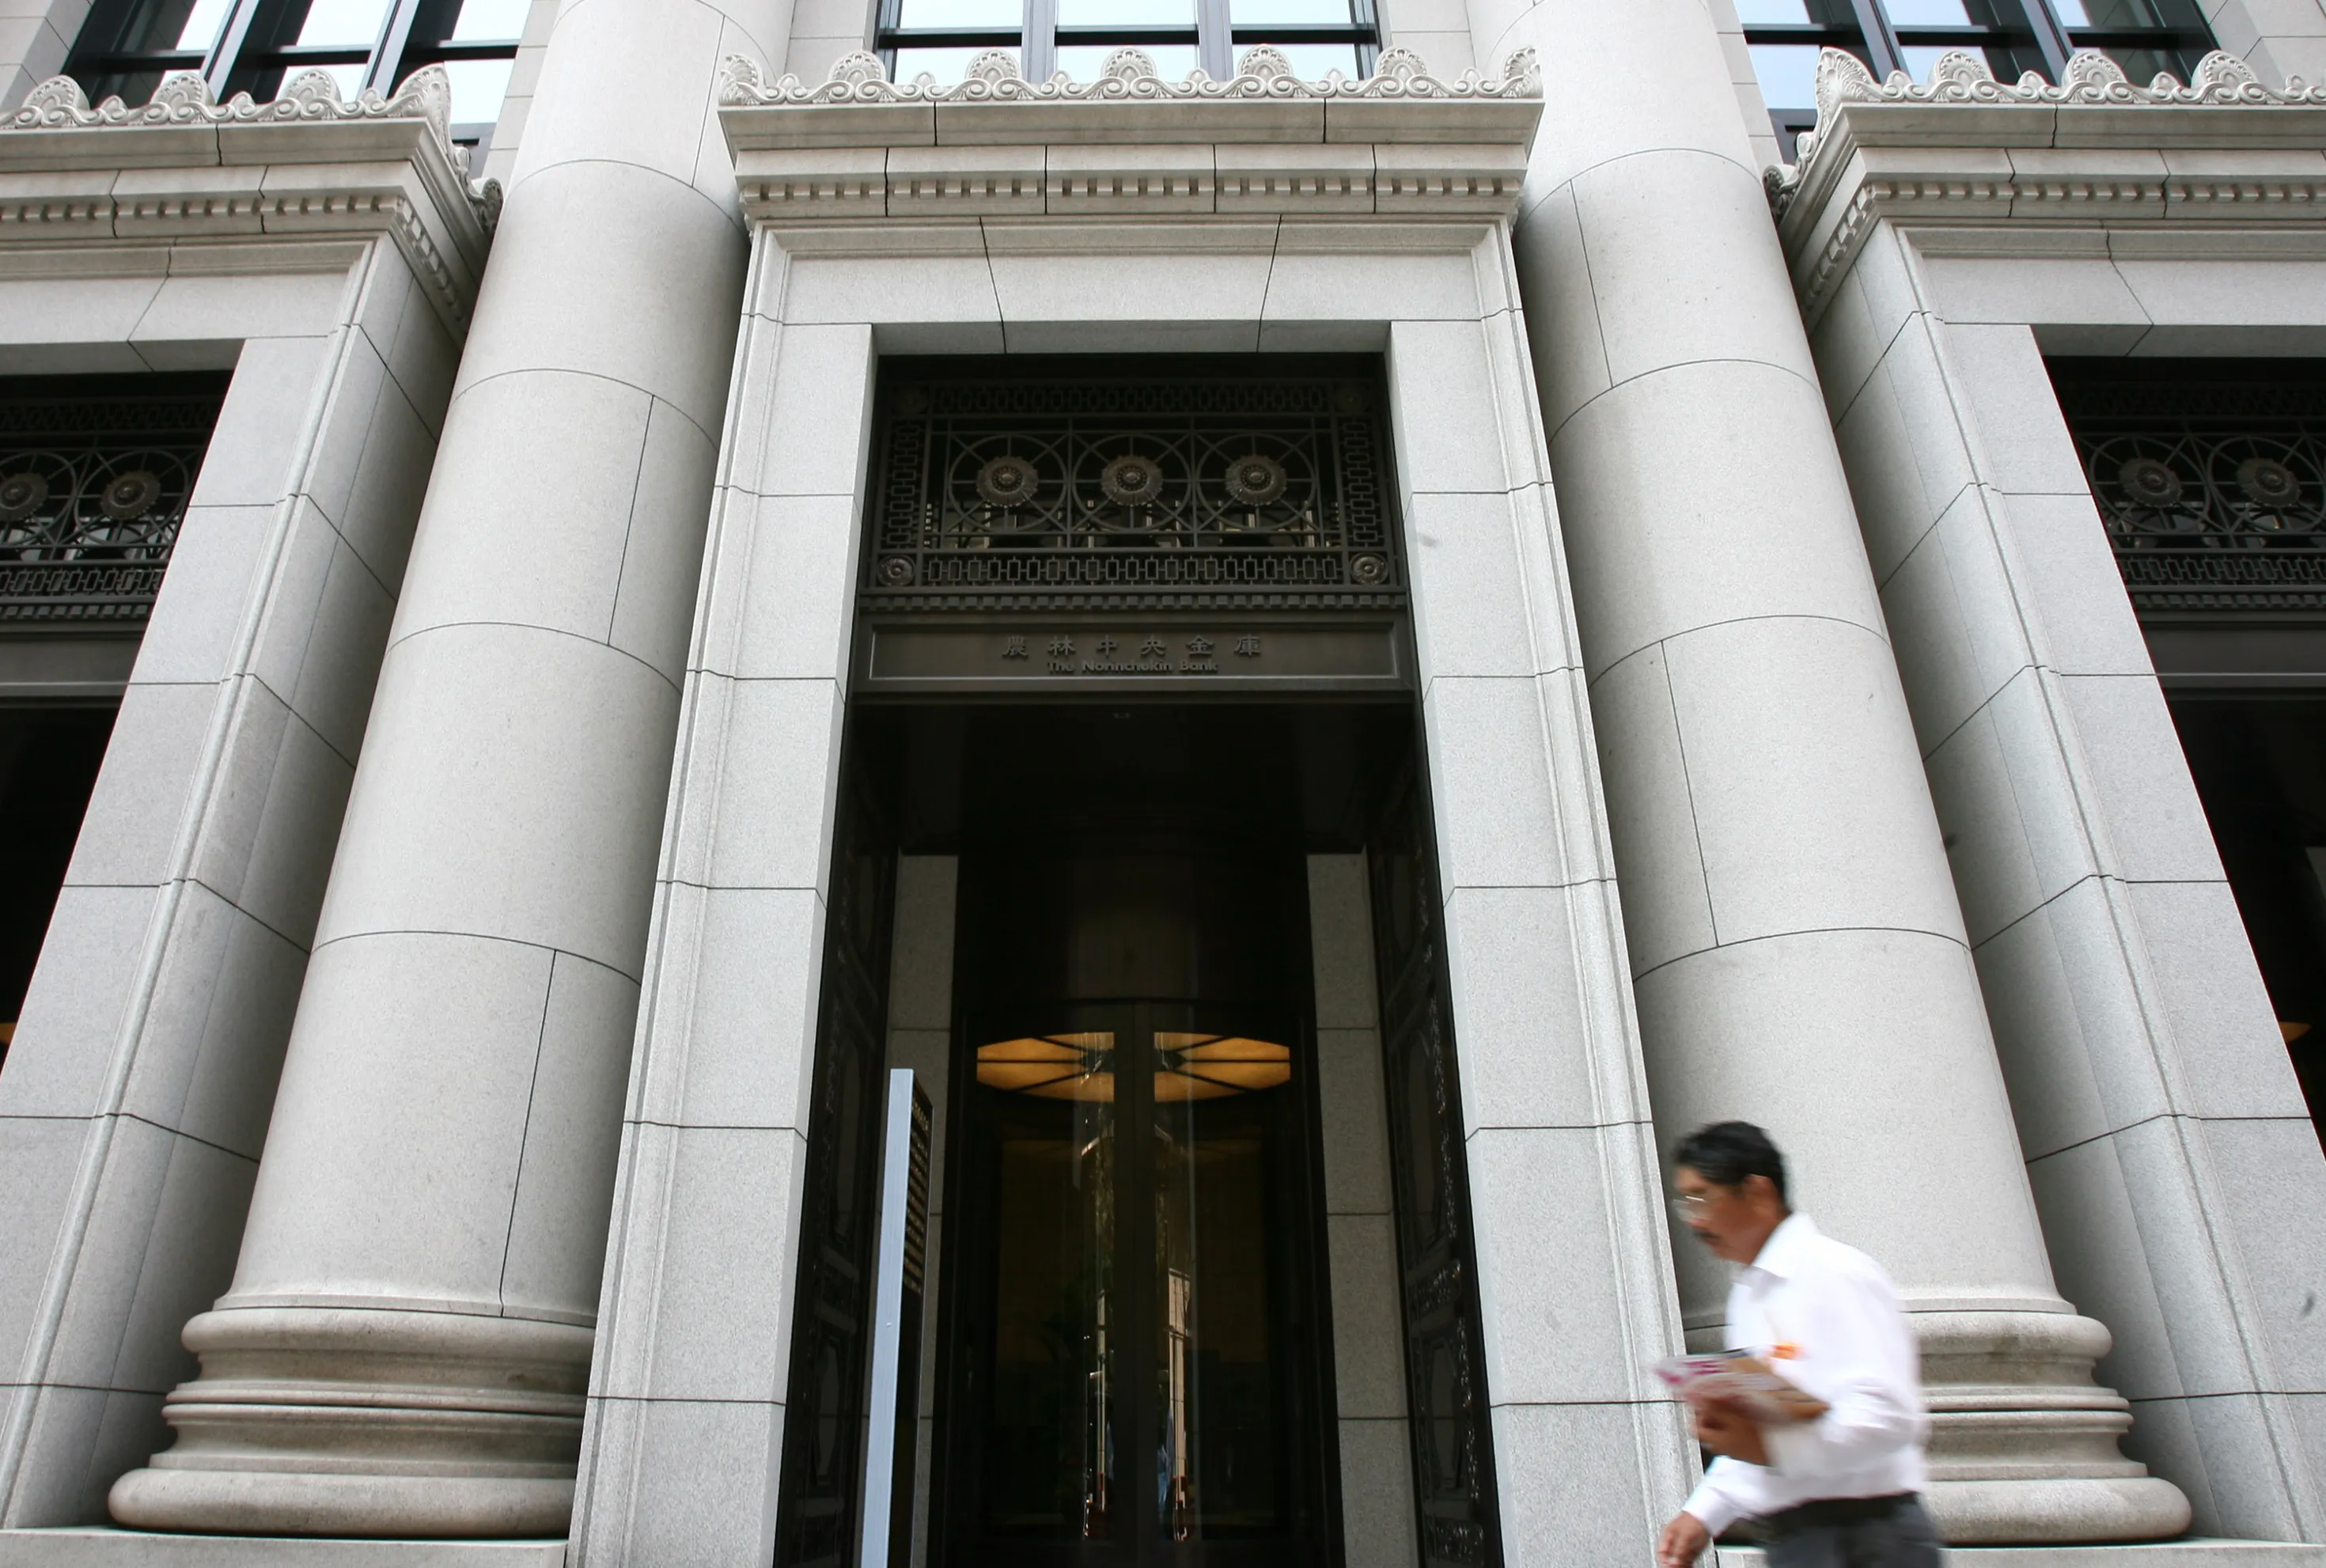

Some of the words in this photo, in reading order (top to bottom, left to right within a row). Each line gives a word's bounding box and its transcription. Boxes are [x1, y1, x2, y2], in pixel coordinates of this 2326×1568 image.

[1002, 634, 1262, 657] 農林中央金庫
[1047, 661, 1074, 674] The
[1180, 659, 1218, 673] Bank
